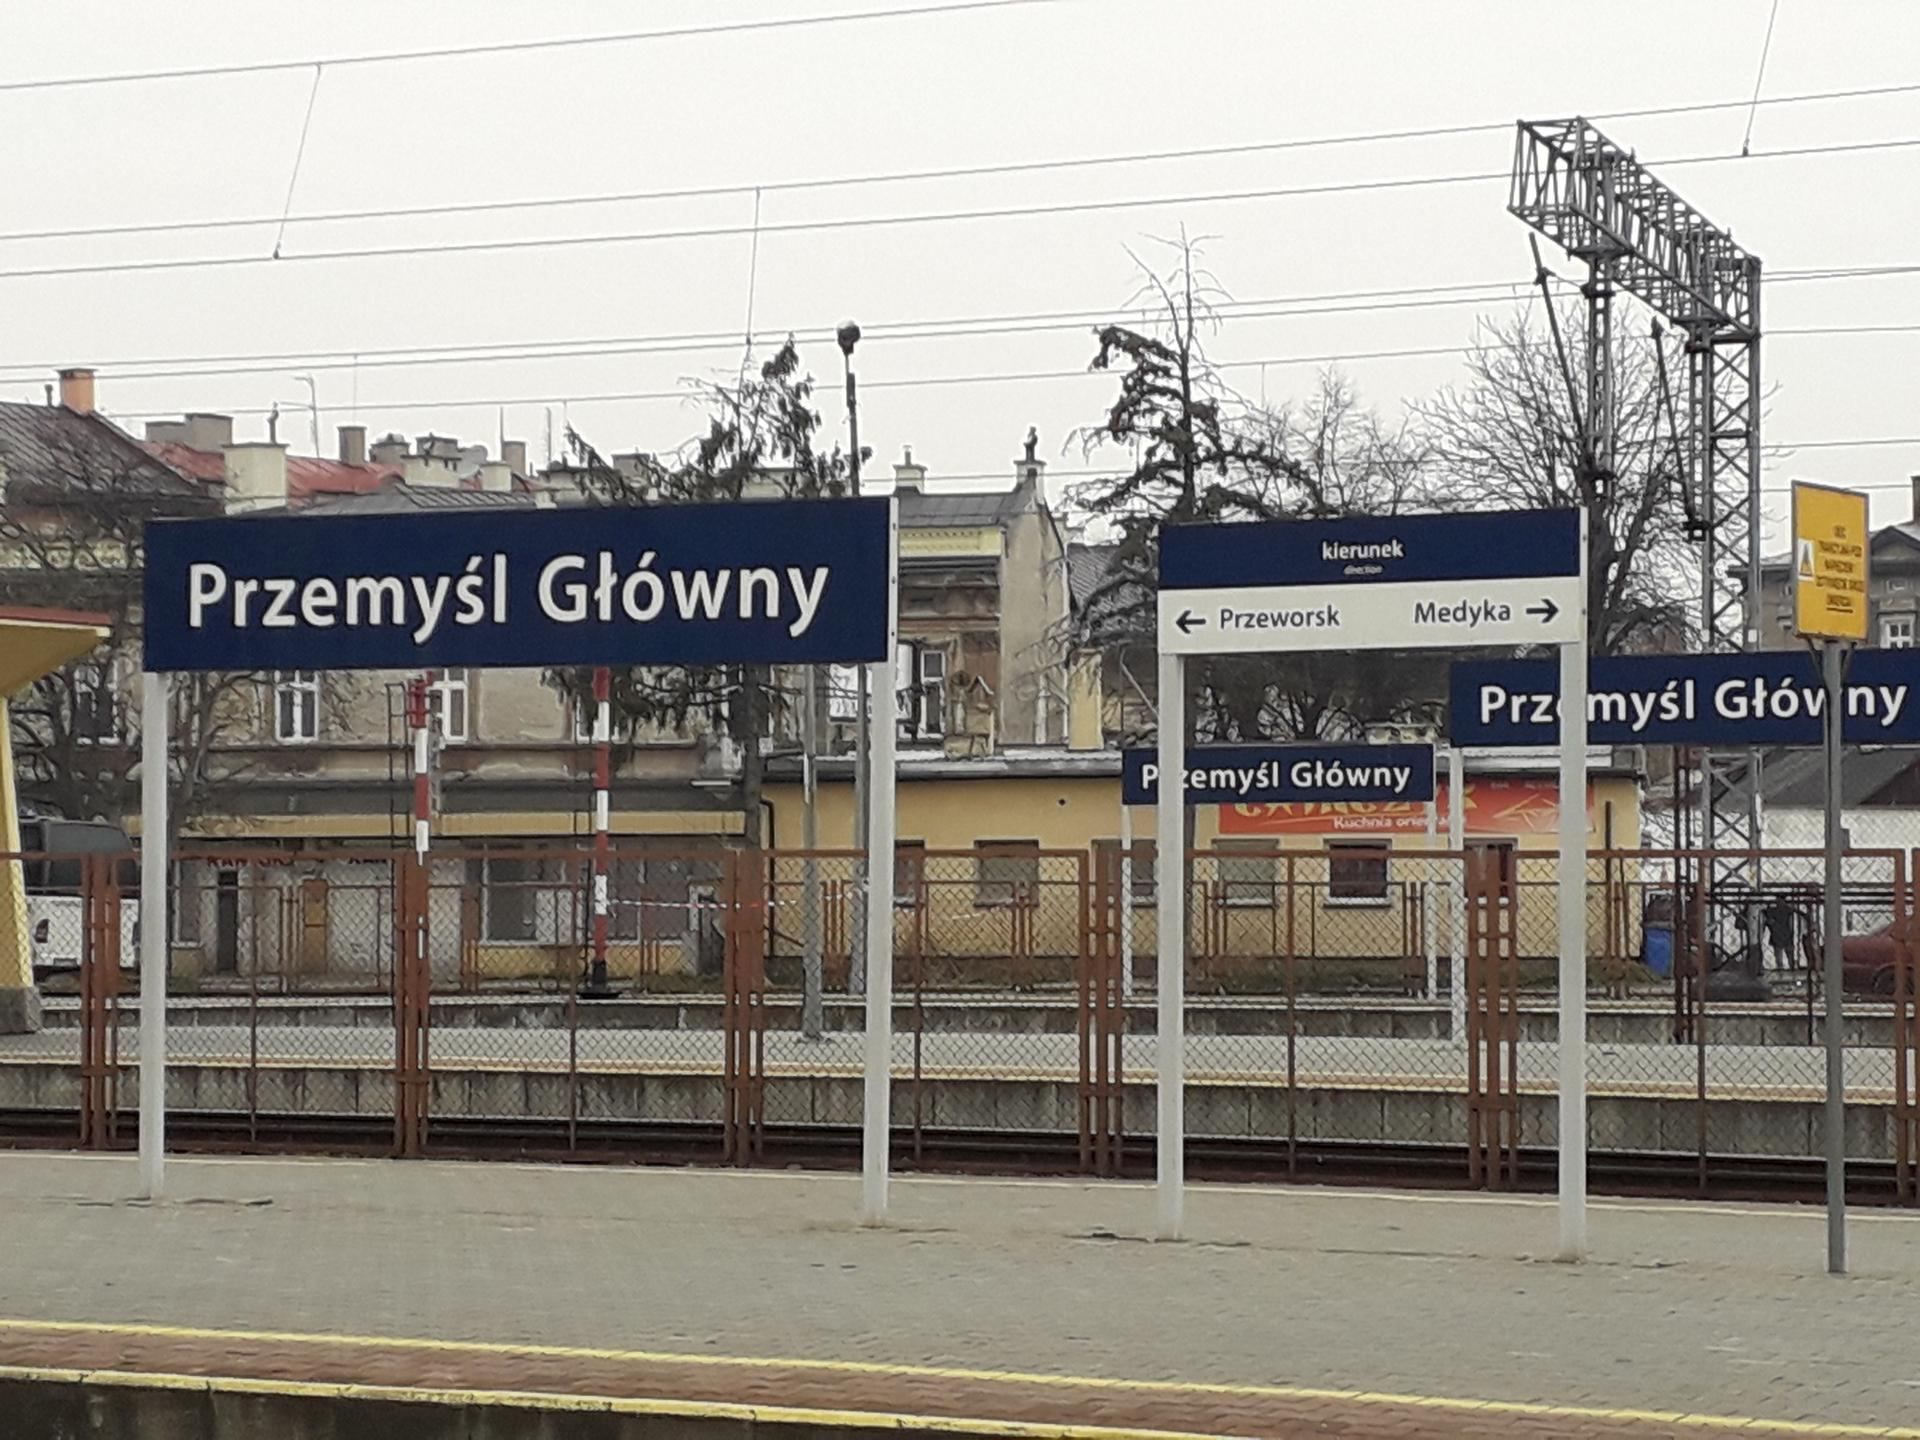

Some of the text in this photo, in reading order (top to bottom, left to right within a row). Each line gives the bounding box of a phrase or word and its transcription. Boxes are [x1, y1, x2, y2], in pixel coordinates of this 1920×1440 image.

[1322, 539, 1404, 560] kierunek
[189, 551, 829, 644] Przemyśl Główny
[1220, 599, 1511, 629] Przeworsk Medyka
[1481, 679, 1695, 732] Przmyśl
[1290, 760, 1411, 794] Główny
